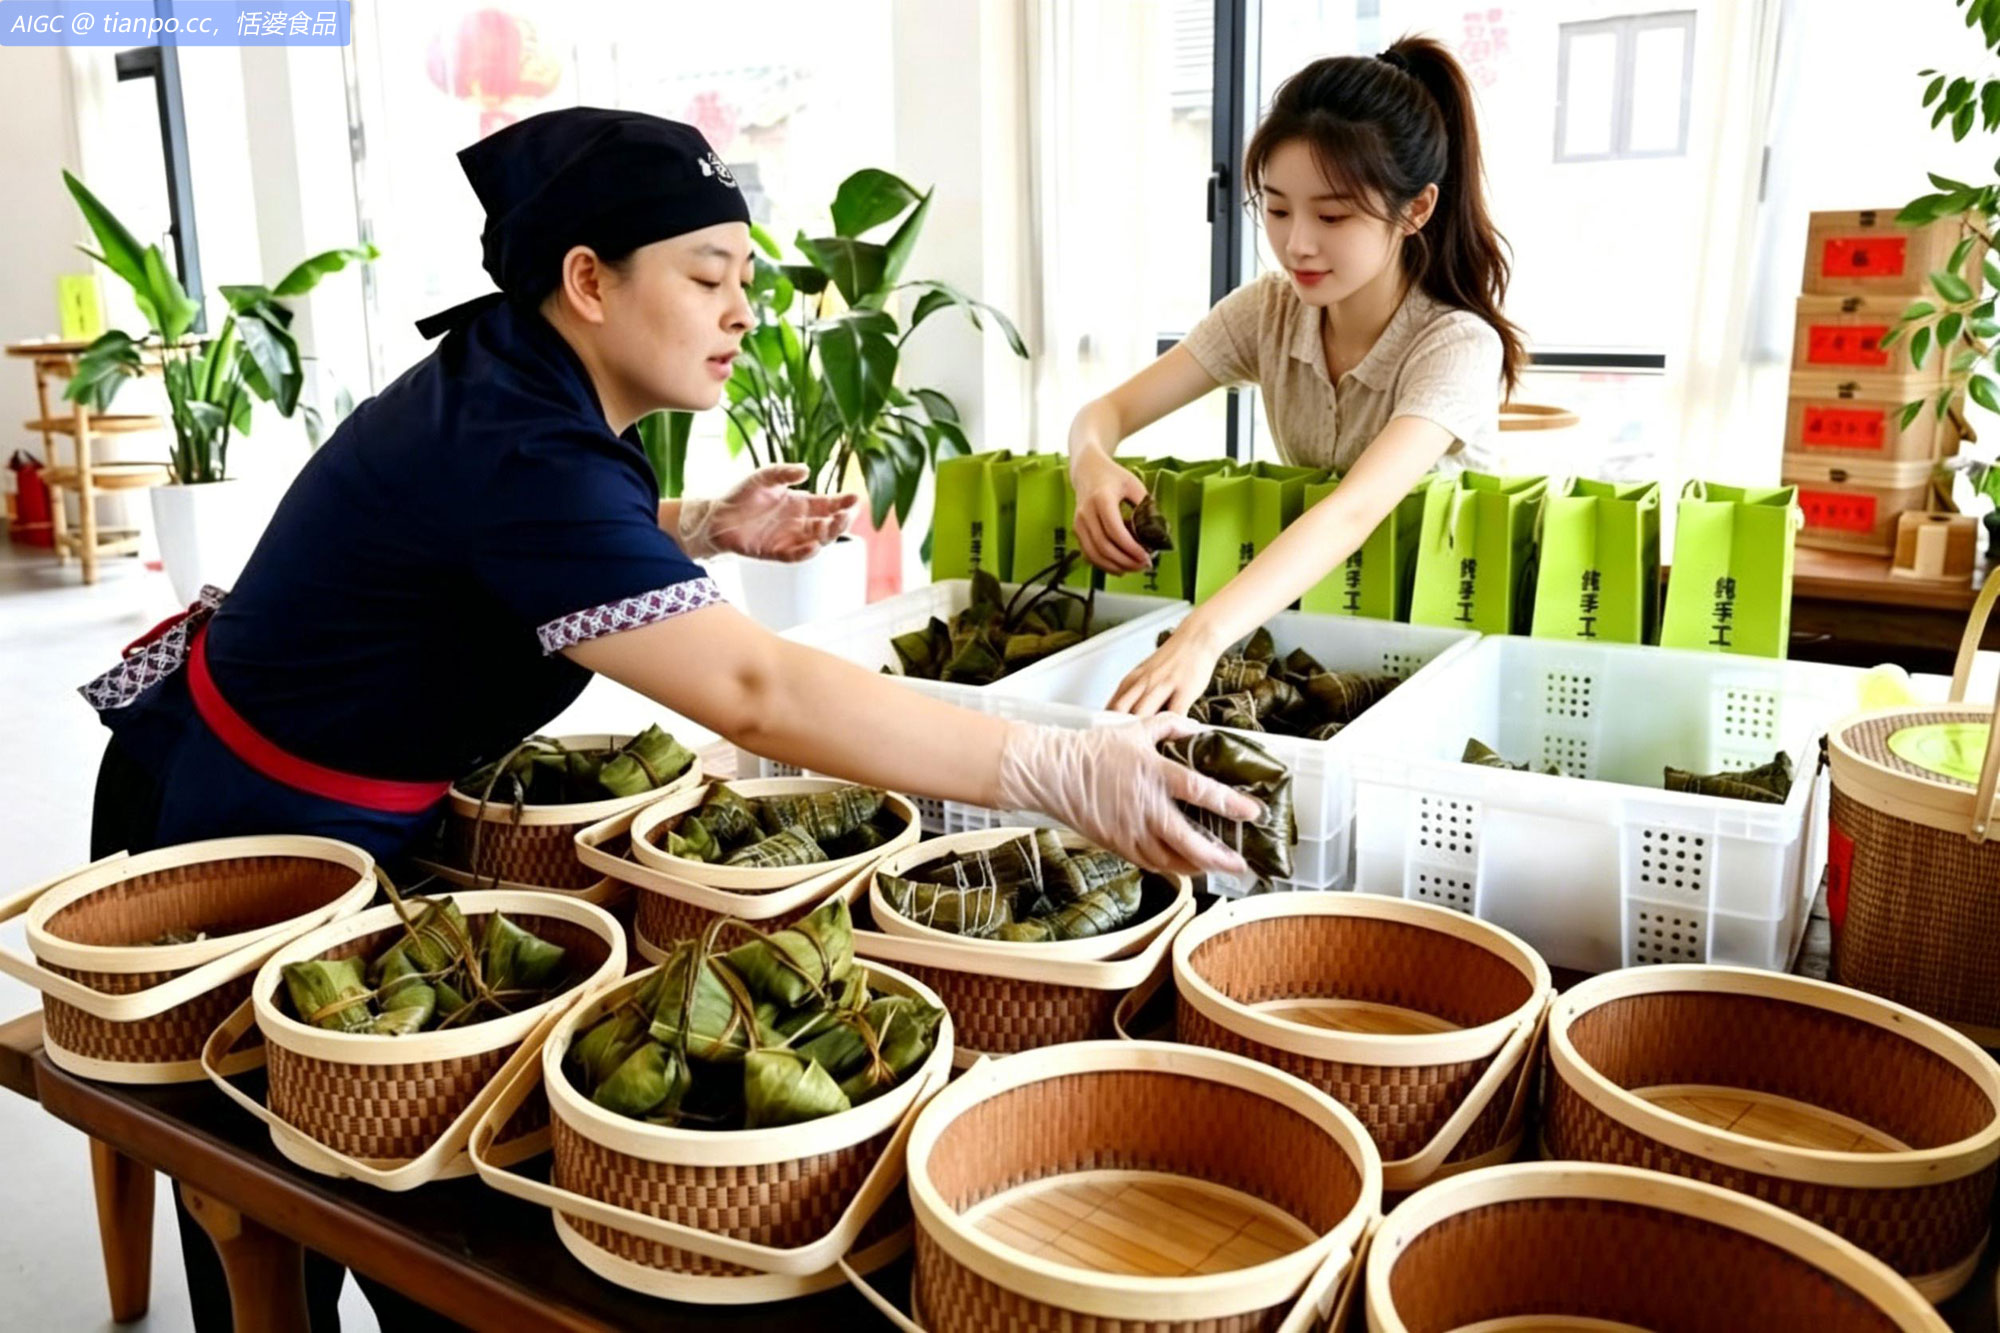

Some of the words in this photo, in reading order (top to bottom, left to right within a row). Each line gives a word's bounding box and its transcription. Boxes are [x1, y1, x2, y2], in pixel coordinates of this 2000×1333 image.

[1453, 557, 1477, 623] 纯手工
[1576, 569, 1601, 637] 纯手工
[1708, 577, 1737, 646] 纯手工
